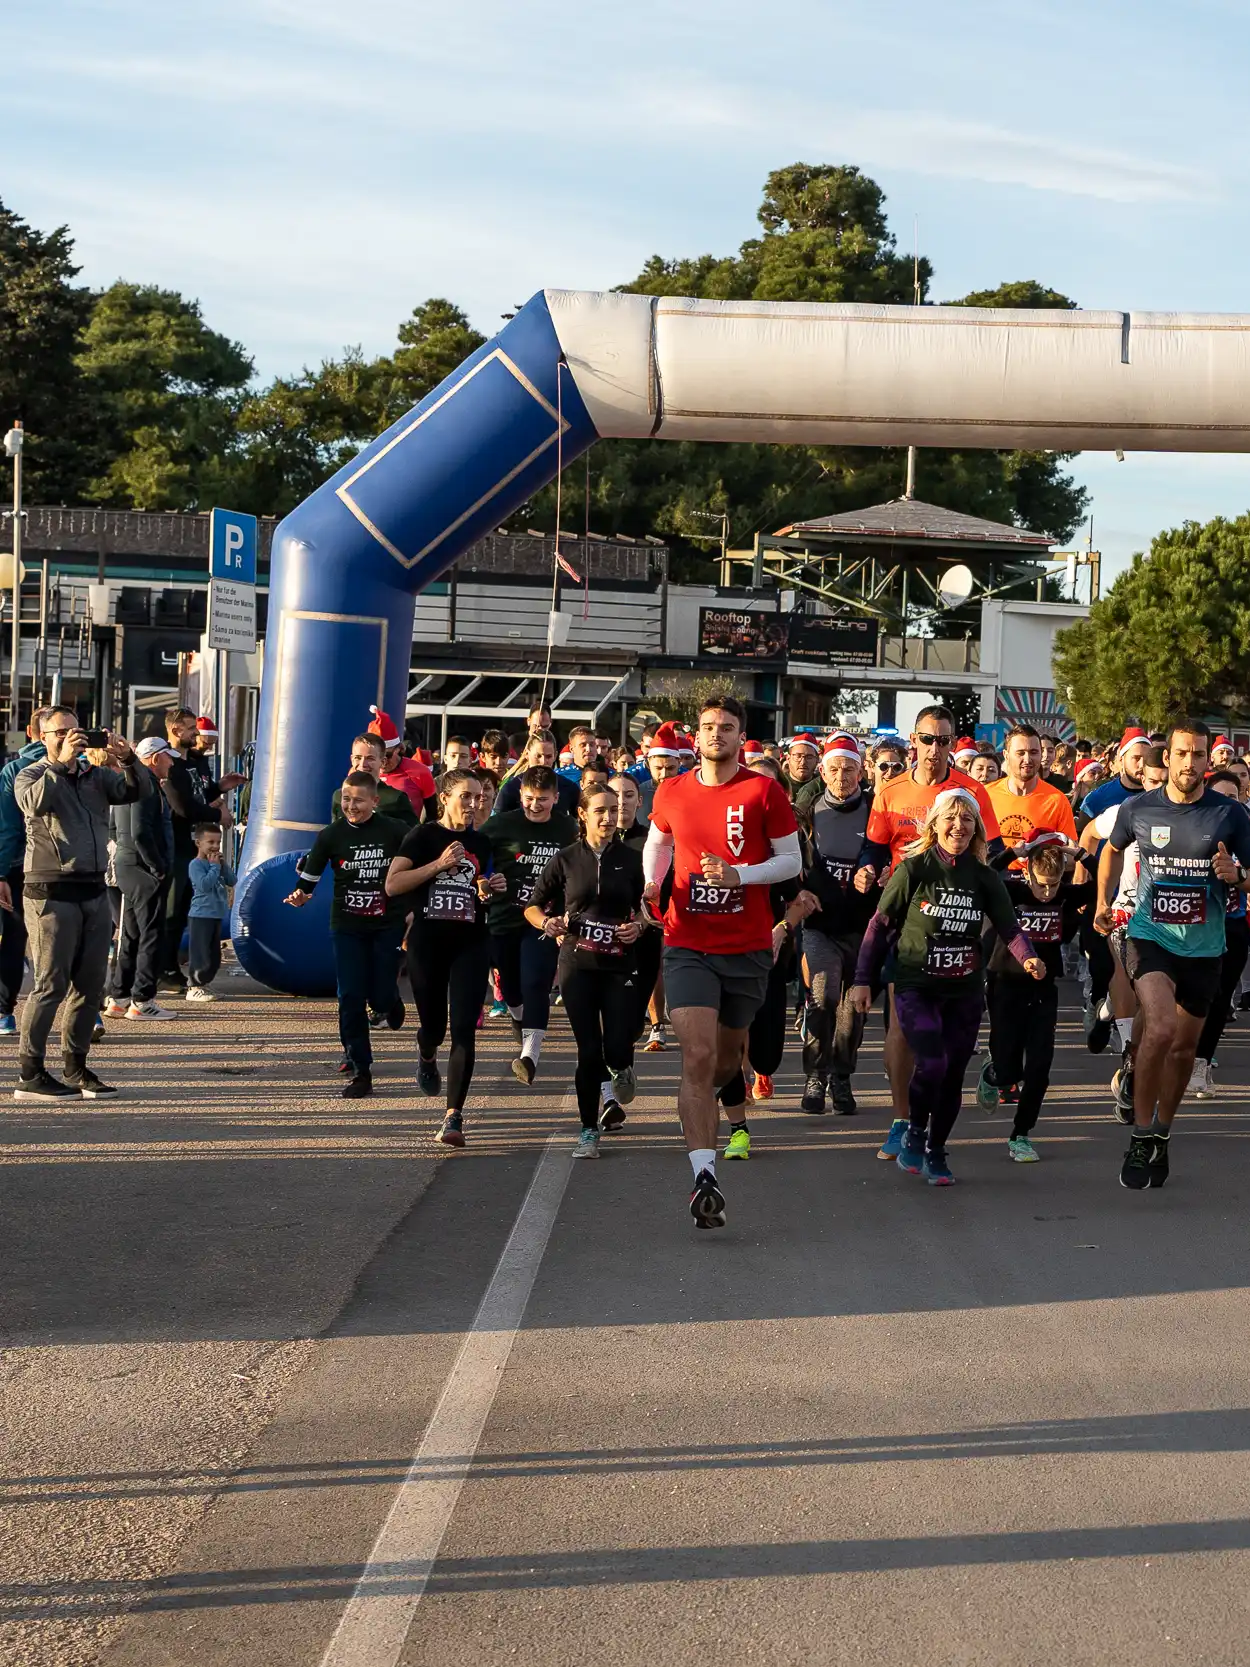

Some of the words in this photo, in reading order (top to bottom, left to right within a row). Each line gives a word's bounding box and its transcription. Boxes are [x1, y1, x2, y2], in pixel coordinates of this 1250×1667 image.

[225, 523, 244, 566] P
[235, 554, 243, 568] R
[704, 610, 752, 626] Rooftop
[726, 804, 745, 857] HRV
[353, 848, 384, 860] ZADAR
[519, 854, 551, 865] CHRIST
[343, 857, 391, 870] CHRISTMAS
[358, 868, 379, 878] RUN
[1154, 866, 1164, 874] Sv.
[1165, 867, 1183, 877] Filip
[1184, 868, 1188, 877] i
[1189, 869, 1209, 877] Jakov
[347, 894, 374, 908] 237
[433, 895, 464, 910] 315
[695, 887, 731, 904] 287
[938, 892, 973, 908] ZADAR
[923, 903, 981, 921] CHRISTMAS
[1157, 897, 1191, 914] 086
[940, 919, 968, 933] RUN
[1021, 917, 1052, 932] 247
[585, 926, 613, 944] 193
[933, 952, 964, 968] 134
